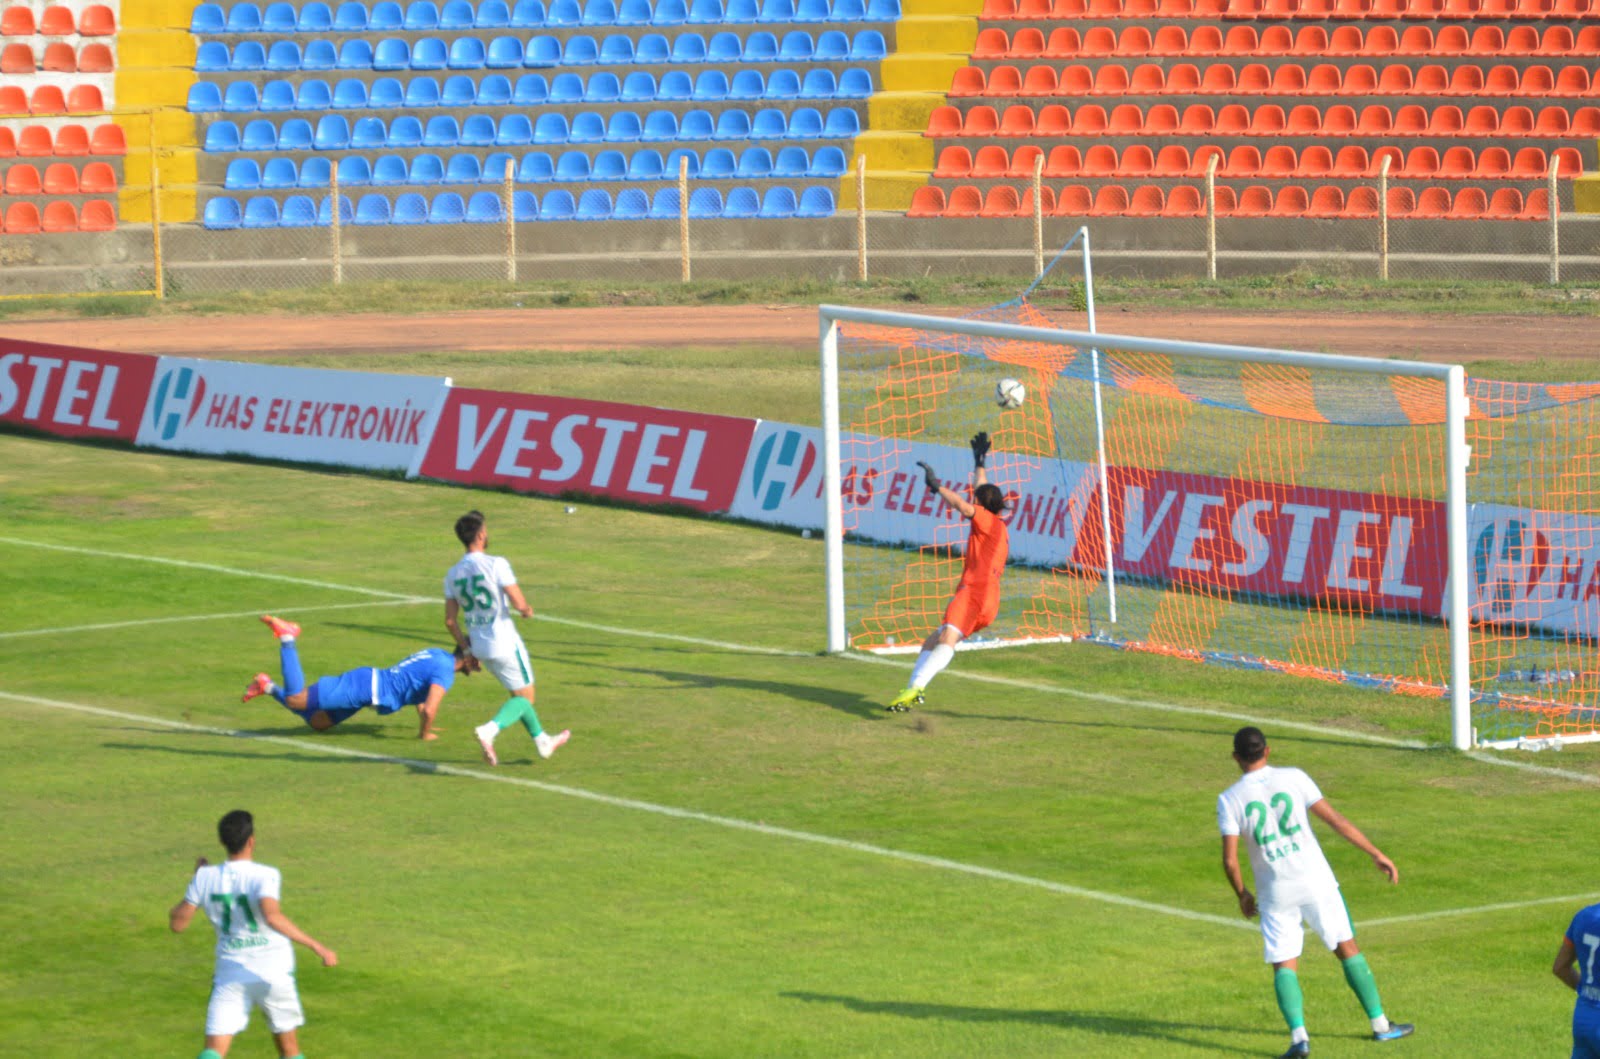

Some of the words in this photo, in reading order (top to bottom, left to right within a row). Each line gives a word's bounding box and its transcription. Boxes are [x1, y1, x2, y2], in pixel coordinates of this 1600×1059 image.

[205, 393, 260, 430] HAS
[264, 398, 427, 446] ELEKTRONİK
[455, 403, 708, 502] VESTEL
[1122, 484, 1424, 599] VESTEL
[454, 574, 493, 613] 35
[1245, 791, 1302, 847] 22
[1266, 842, 1301, 863] SAFA
[210, 893, 258, 935] 71
